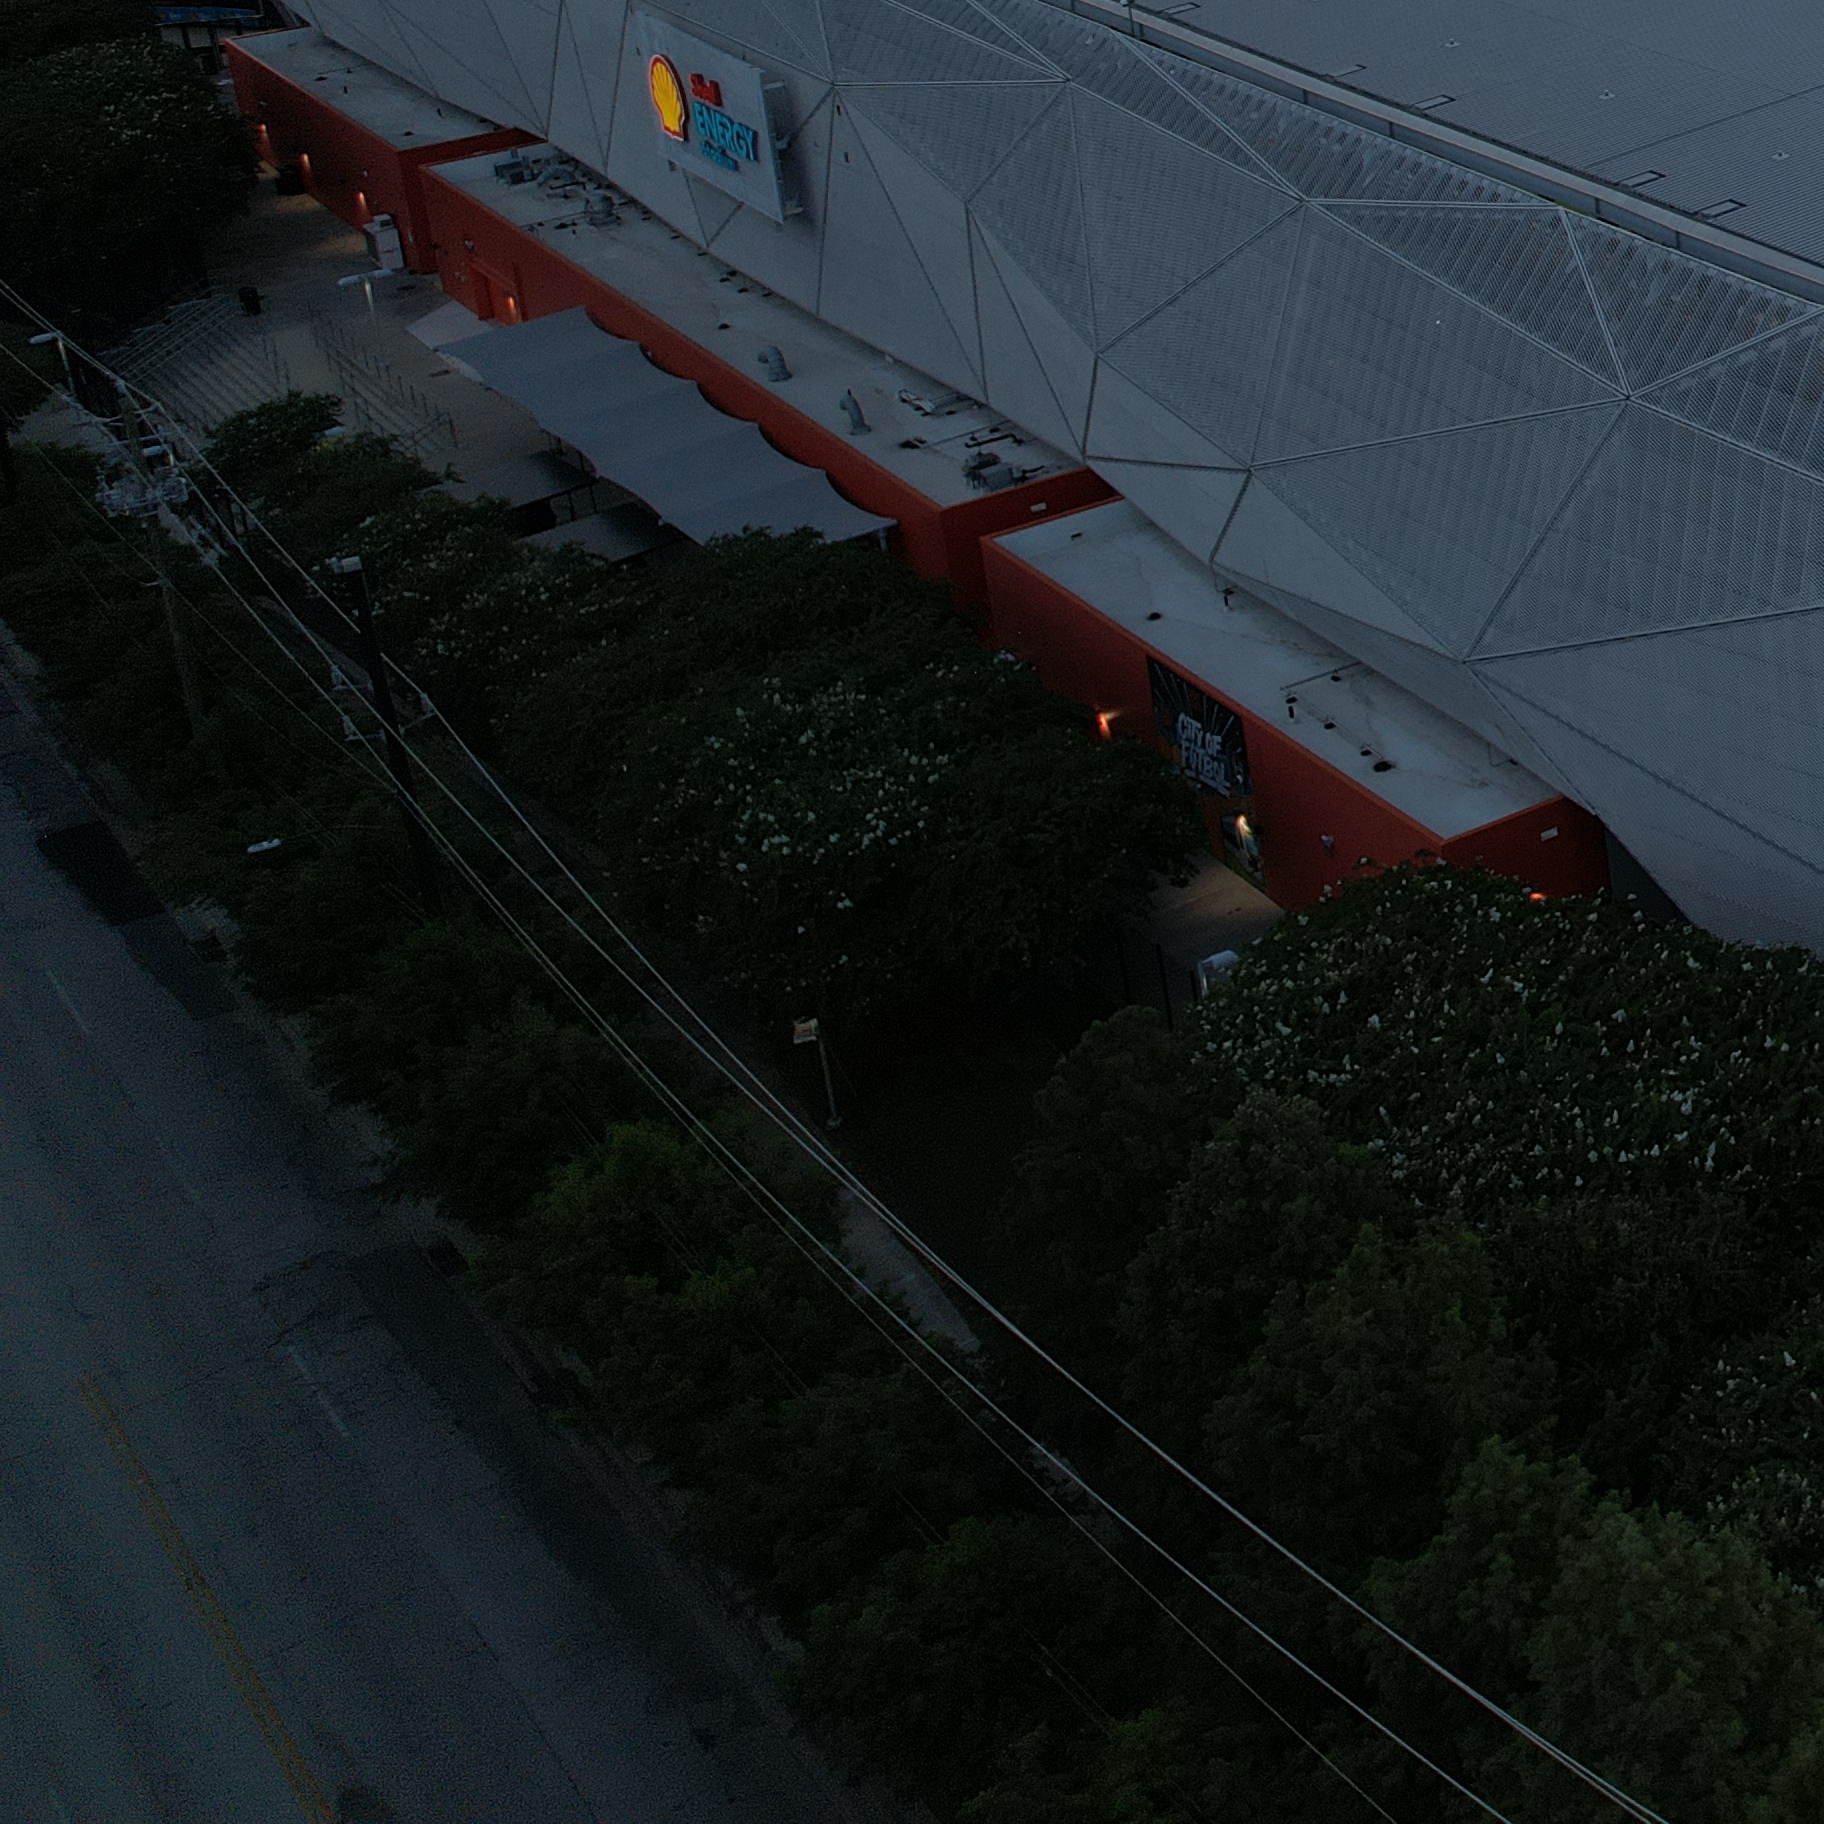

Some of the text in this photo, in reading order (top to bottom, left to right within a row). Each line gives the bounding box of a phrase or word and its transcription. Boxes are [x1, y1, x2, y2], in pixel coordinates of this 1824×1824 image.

[689, 73, 723, 107] Shell
[692, 101, 758, 162] ENERGY
[1176, 711, 1223, 757] CITY OF
